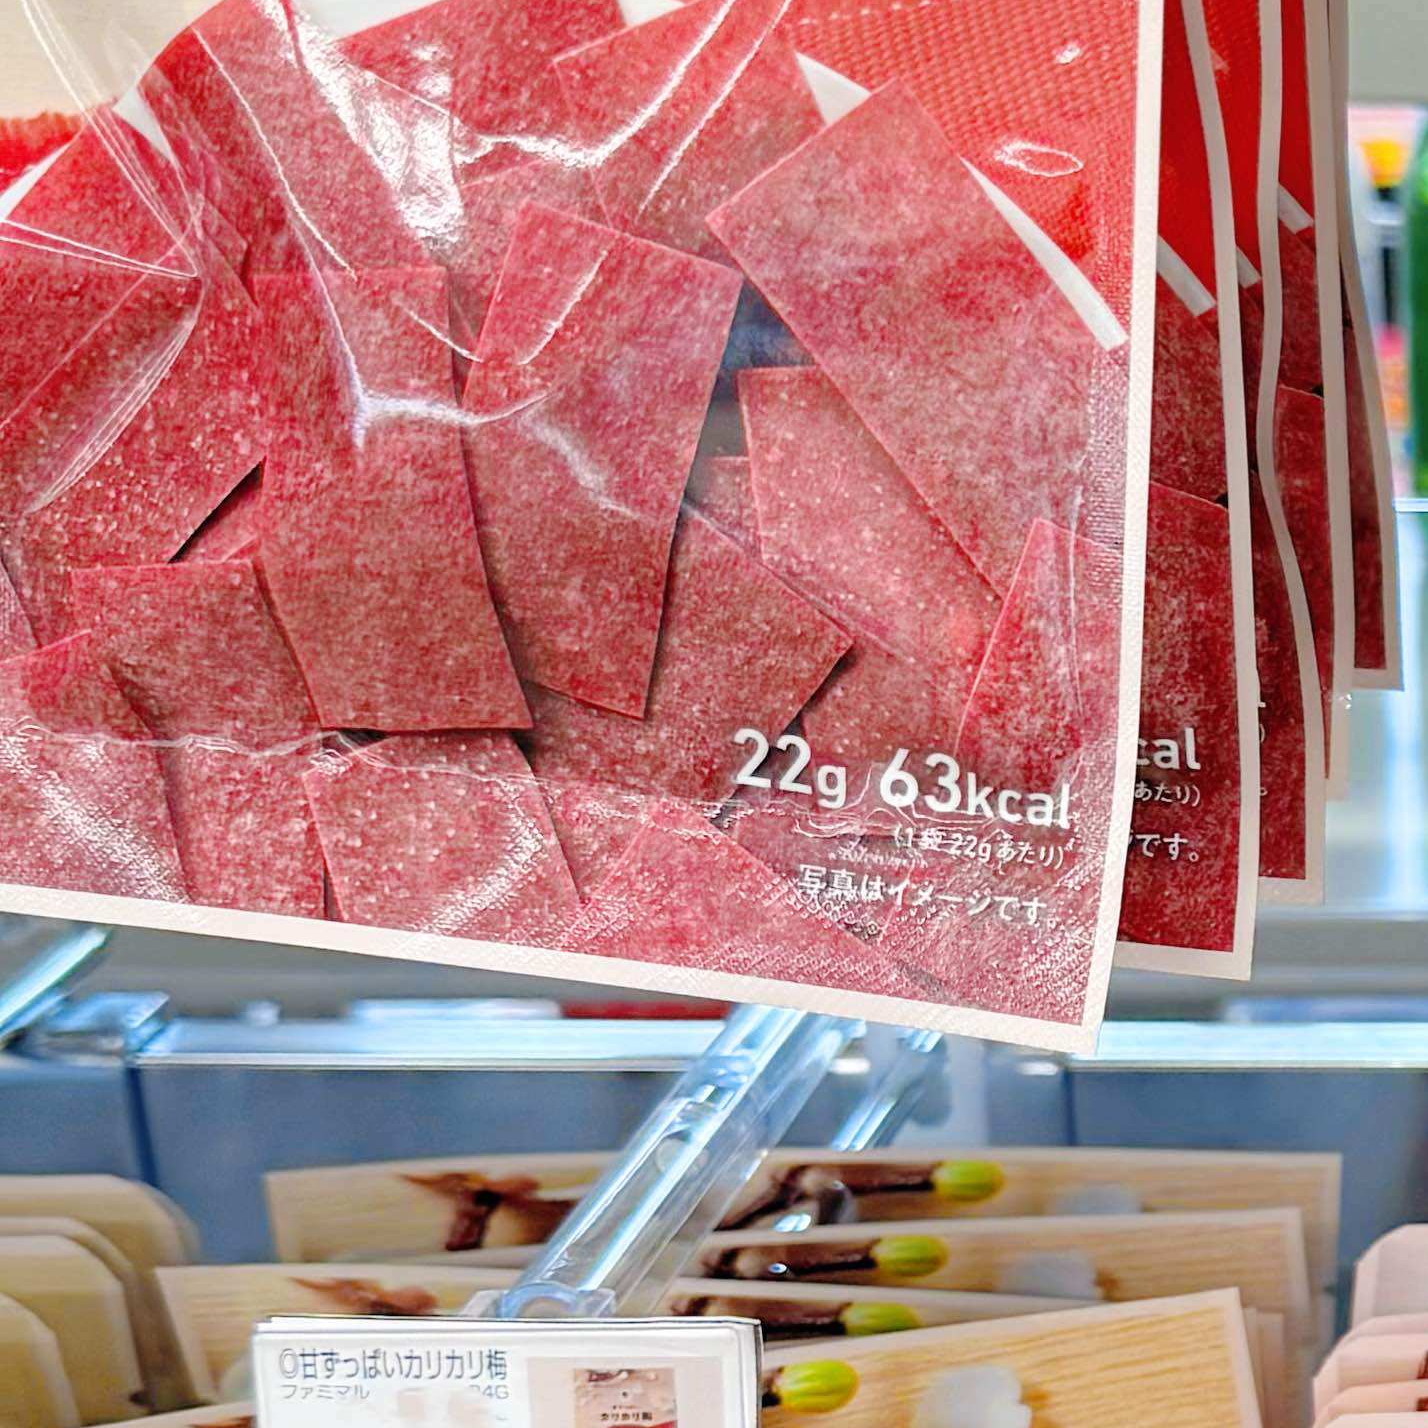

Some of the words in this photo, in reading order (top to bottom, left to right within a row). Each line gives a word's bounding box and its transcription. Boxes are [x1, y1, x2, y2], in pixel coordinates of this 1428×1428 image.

[732, 726, 848, 808] 22g
[879, 747, 1072, 829] 63kcal
[1128, 829, 1200, 863] です。
[280, 1383, 370, 1400] ファミマル
